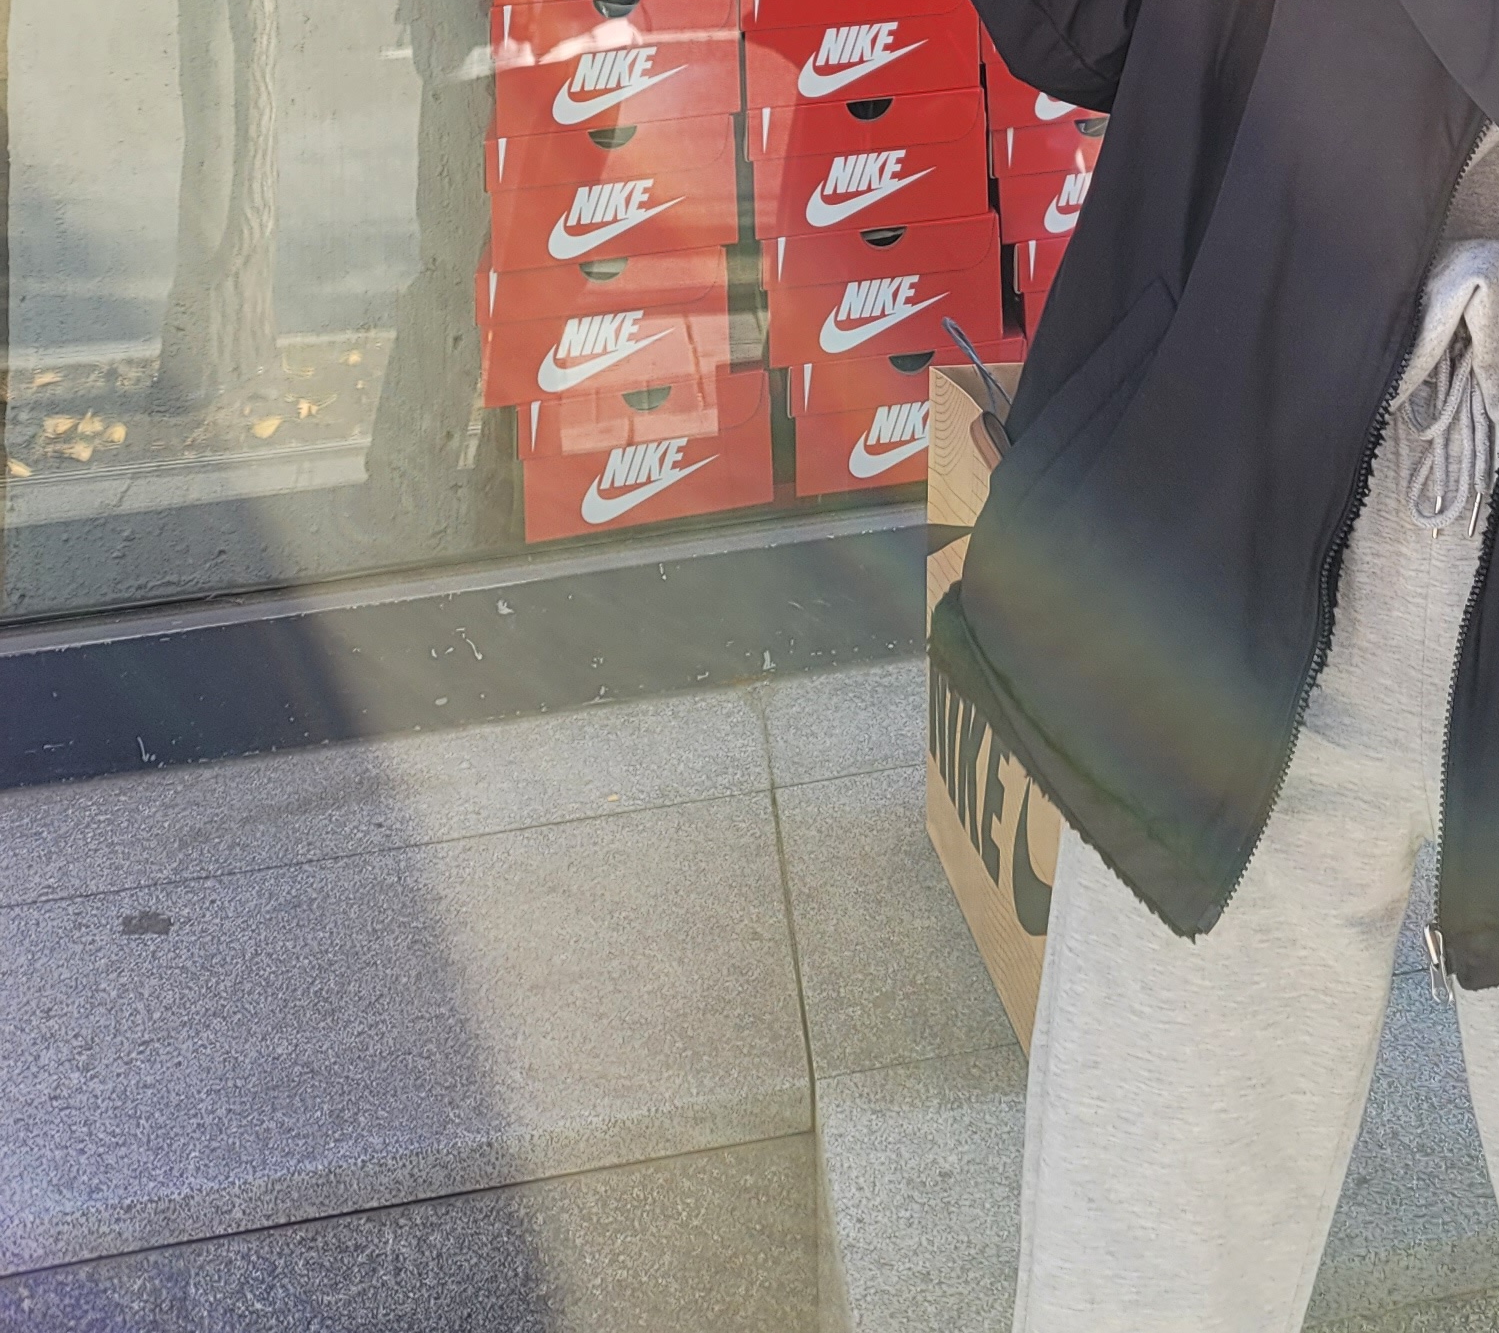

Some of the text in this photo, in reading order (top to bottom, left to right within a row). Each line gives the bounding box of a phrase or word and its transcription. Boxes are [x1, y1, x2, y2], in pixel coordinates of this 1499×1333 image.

[817, 22, 899, 64] NIKE
[572, 48, 656, 93] NIKE
[826, 149, 905, 192] NIKE
[569, 178, 653, 226] NIKE
[836, 275, 919, 319] NIKE
[559, 310, 643, 358] NIKE
[867, 400, 928, 441] NIK
[601, 438, 687, 486] NIKE
